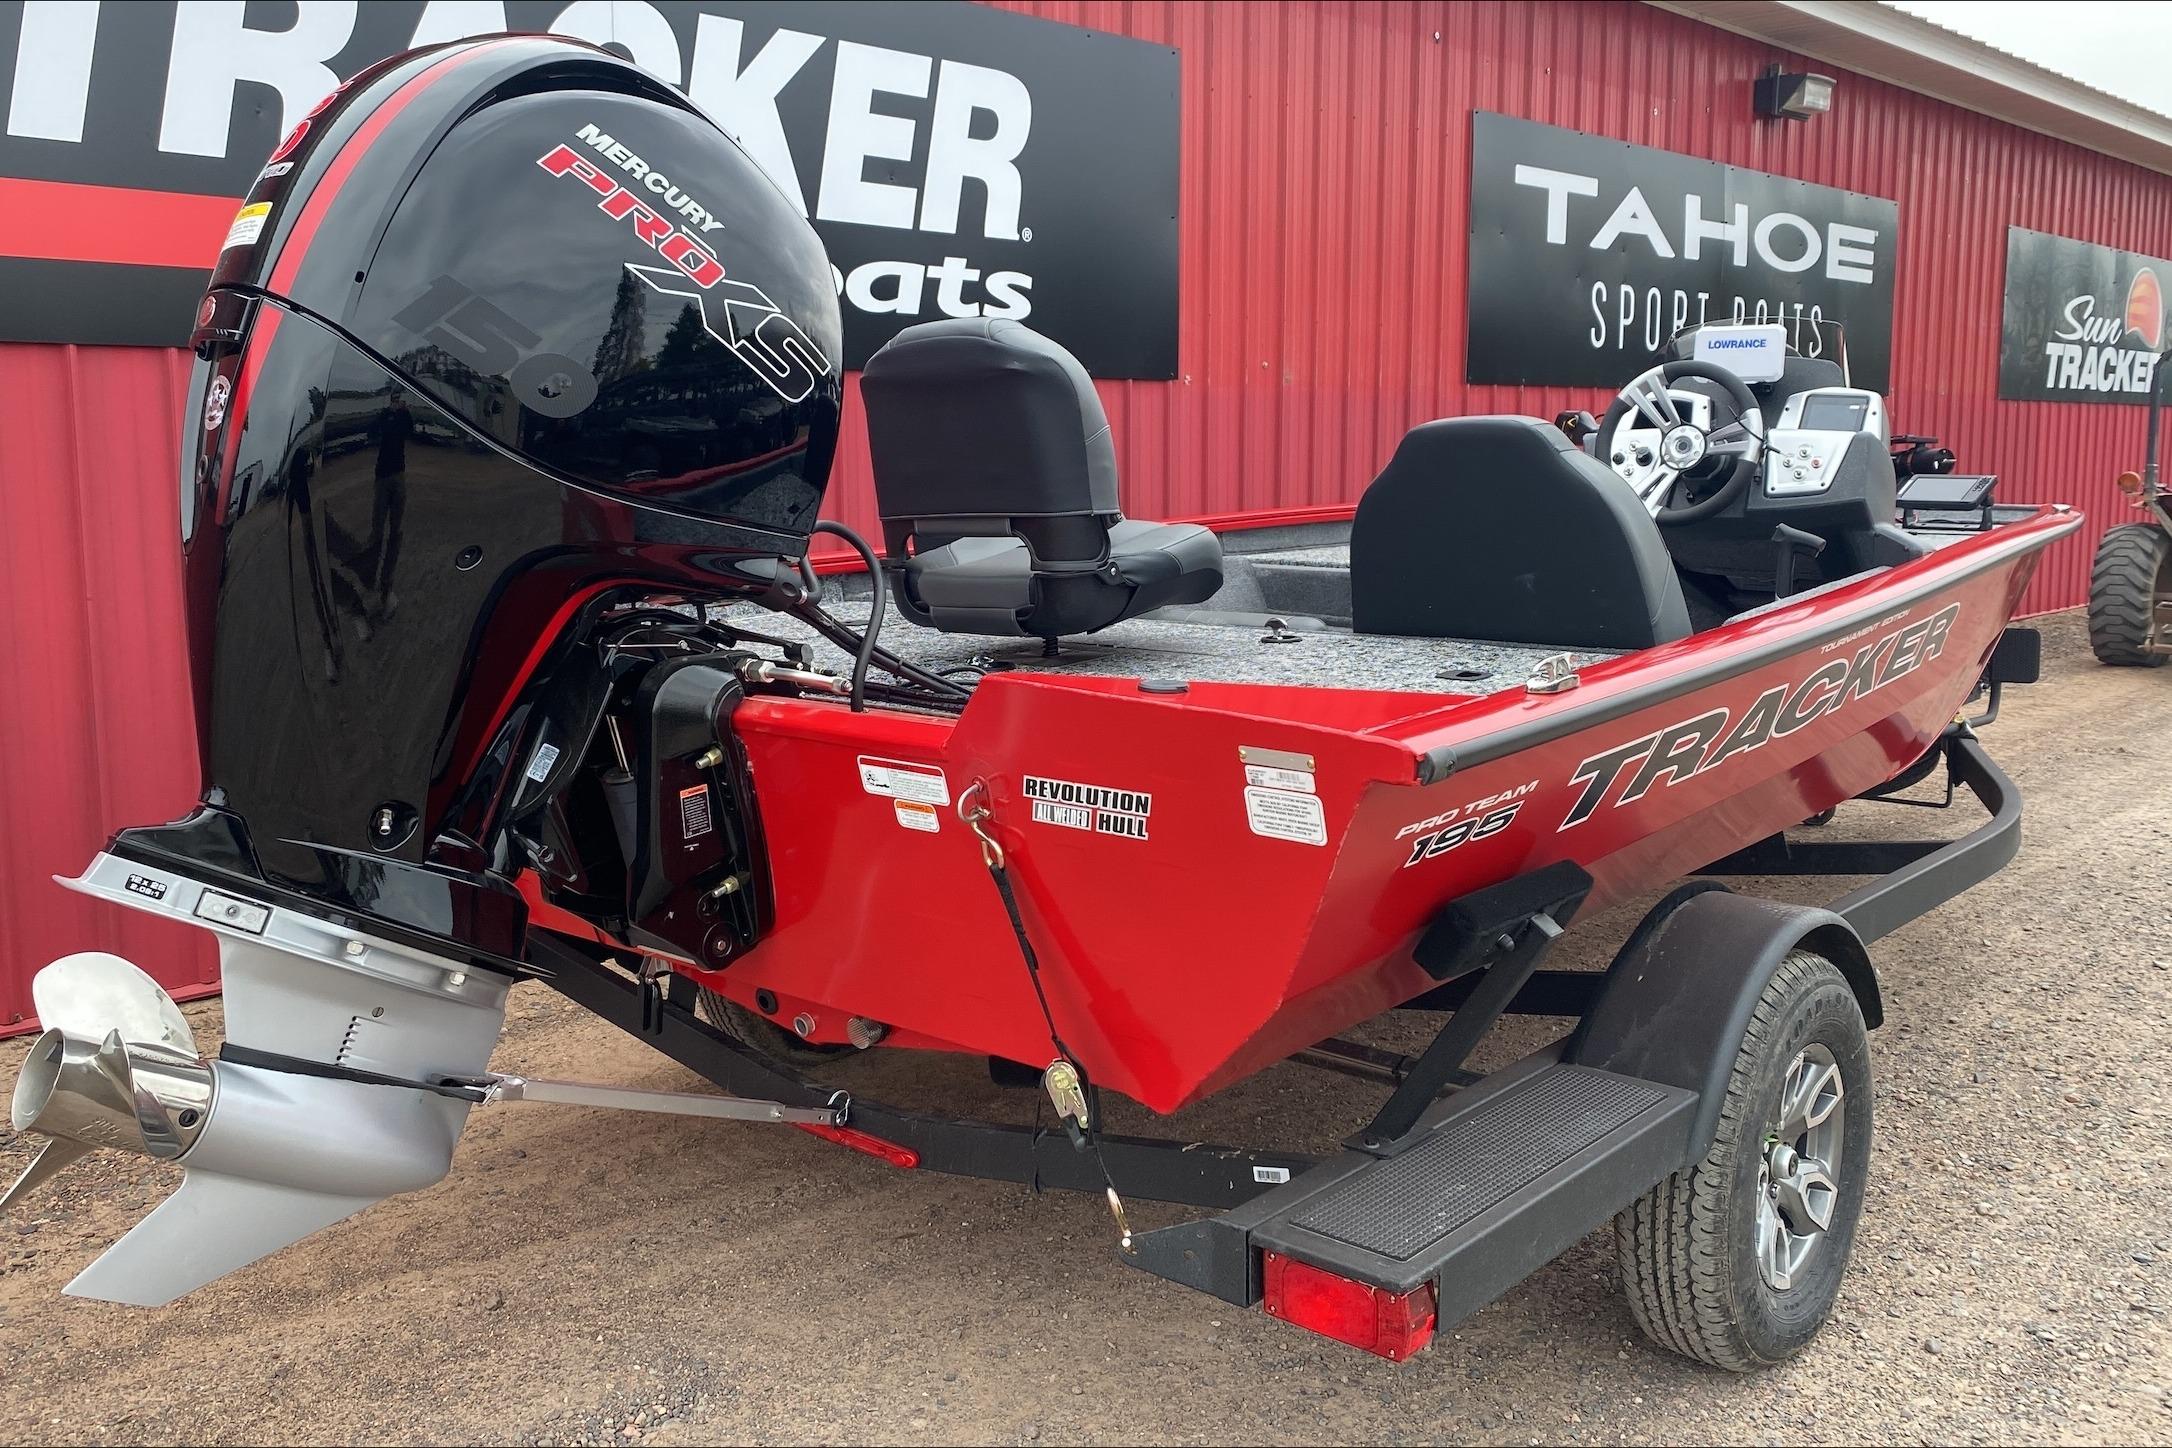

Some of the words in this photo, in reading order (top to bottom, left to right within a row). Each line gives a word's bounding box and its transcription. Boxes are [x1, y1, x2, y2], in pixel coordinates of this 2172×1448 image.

[7, 0, 1034, 241] RKER
[575, 123, 726, 233] MERCURY
[536, 143, 726, 289] PRO
[1515, 163, 1877, 284] TAHOE
[623, 225, 832, 403] XS
[830, 256, 1033, 321] ats
[1590, 280, 1710, 351] SPORT
[2054, 294, 2123, 345] Sun
[391, 274, 599, 419] 150
[1708, 338, 1767, 350] LOWRANCE
[1820, 621, 1881, 655] TOURNAMENT
[1881, 608, 1911, 627] EDITION
[1556, 601, 1961, 833] TRACKER
[1025, 777, 1150, 814] REVOLUTION
[1036, 802, 1052, 821] ALL
[1052, 805, 1089, 828] WELDED
[1098, 813, 1146, 838] HULL
[1394, 808, 1460, 841] PRO
[1464, 779, 1540, 815] TEAM
[1403, 799, 1526, 869] 195
